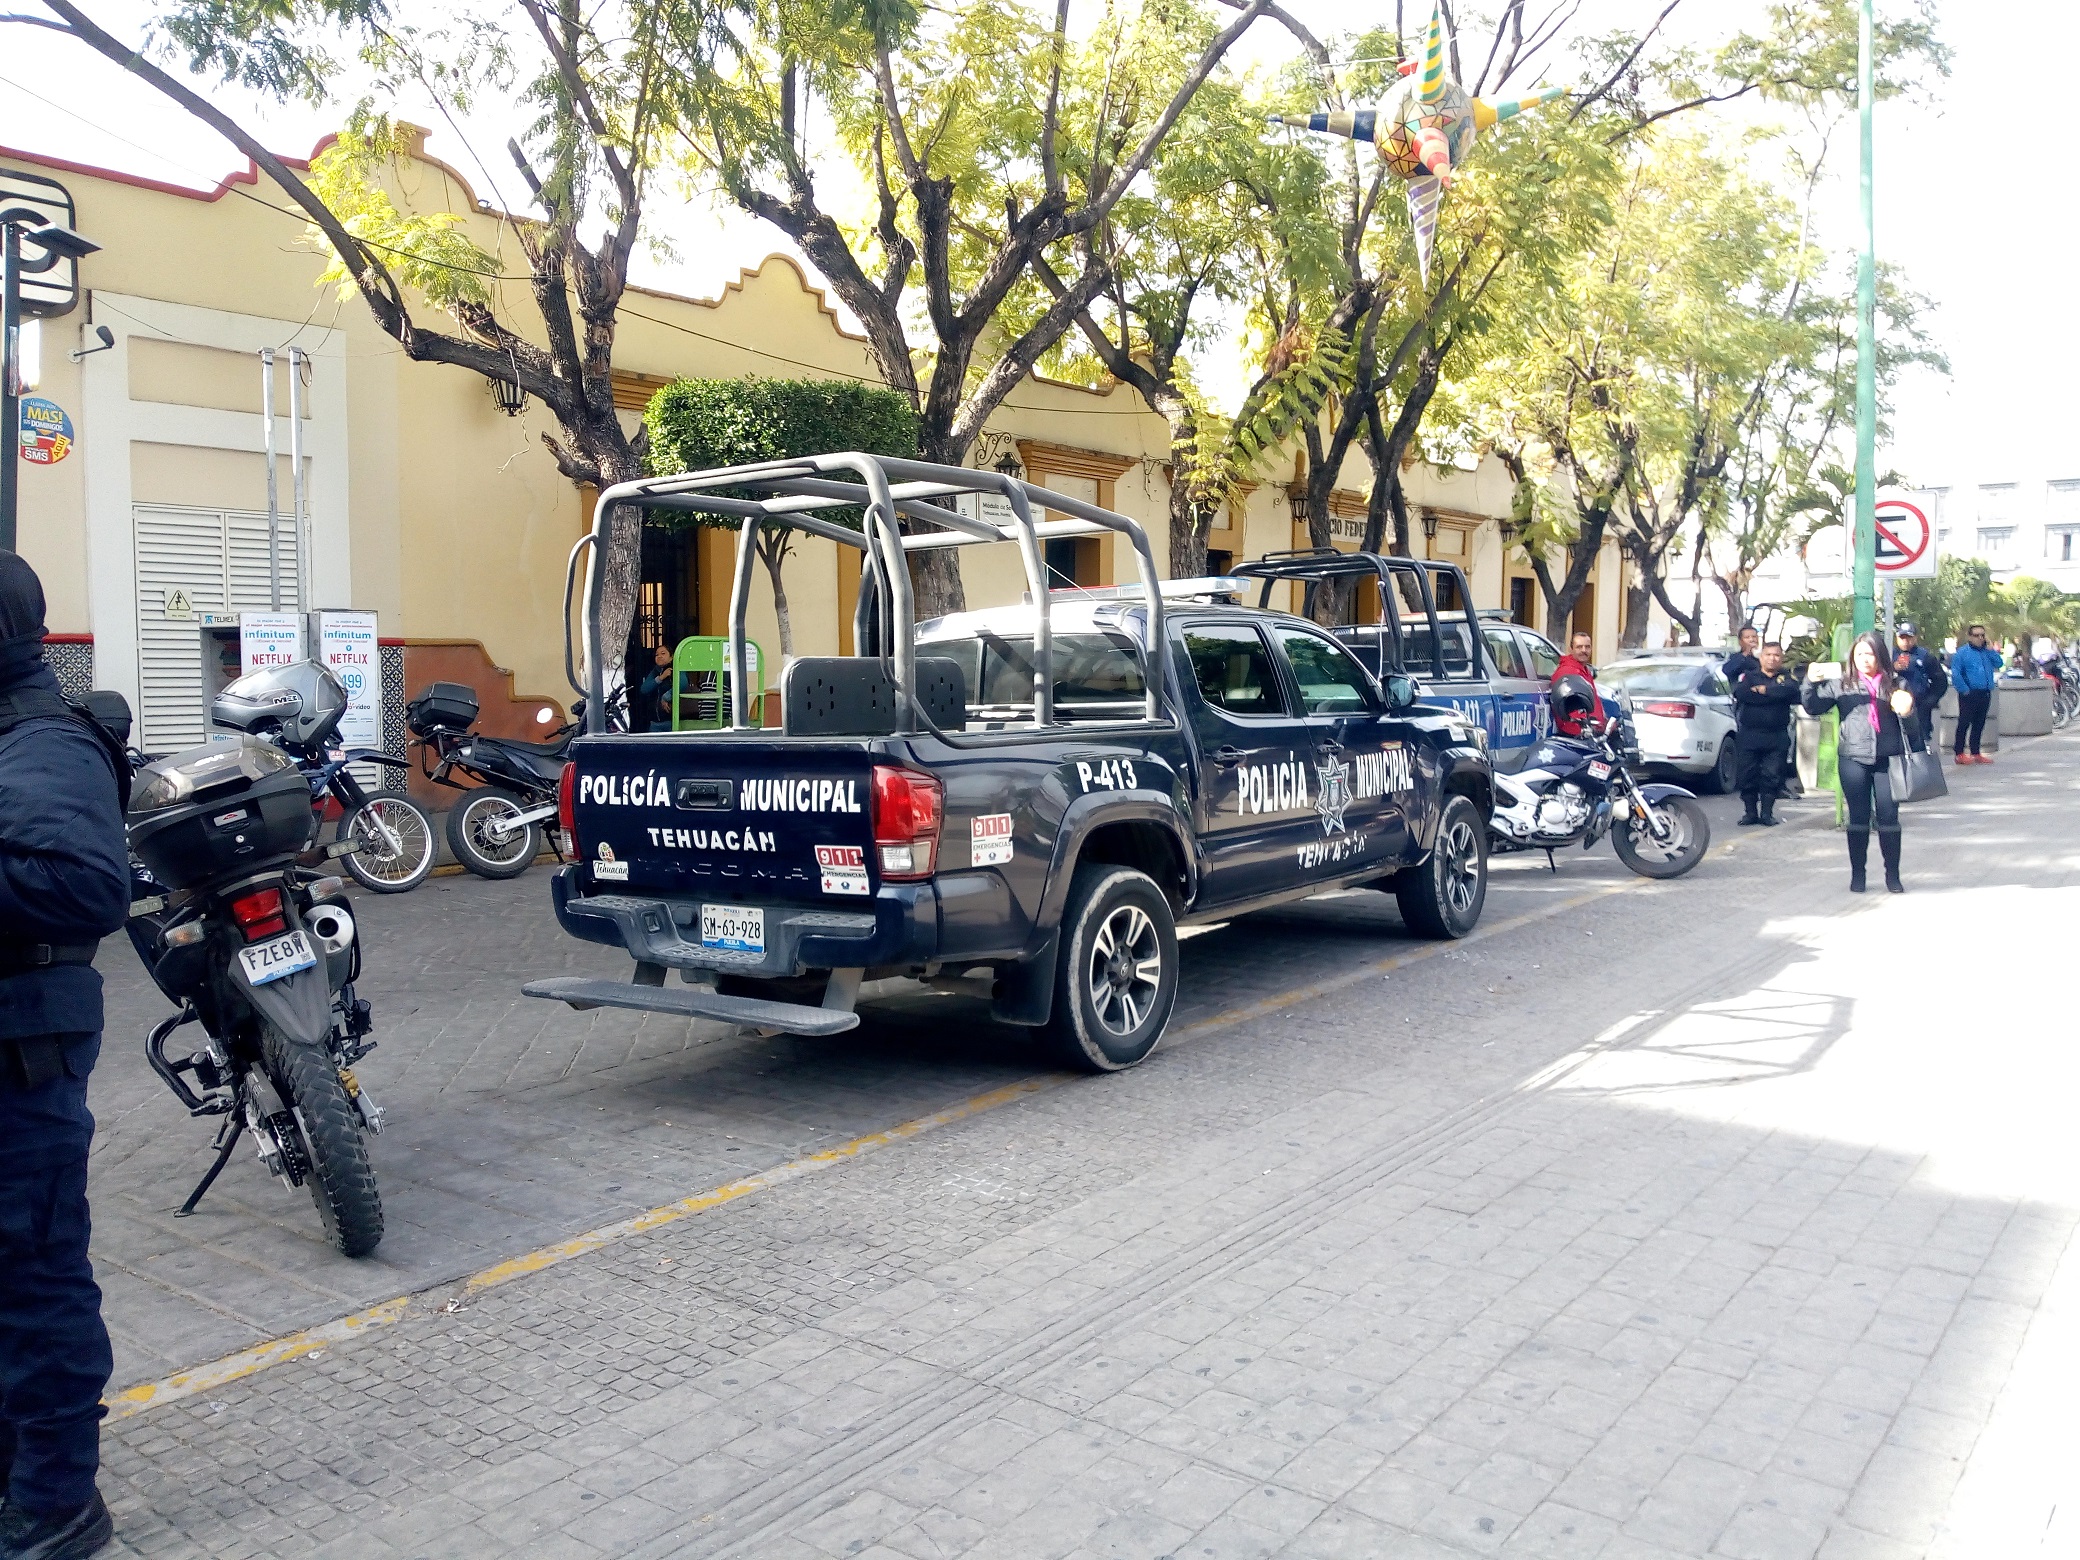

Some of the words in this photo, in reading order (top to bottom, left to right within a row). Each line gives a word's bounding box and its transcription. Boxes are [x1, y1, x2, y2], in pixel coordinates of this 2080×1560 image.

[27, 405, 63, 424] MÁS!
[31, 420, 63, 432] DOMINGOS
[25, 449, 48, 461] SMS
[245, 630, 295, 639] infinitum
[324, 630, 371, 639] infinitum
[252, 653, 292, 665] NETFLIX
[330, 653, 368, 664] NETFLIX
[1502, 705, 1531, 737] POLICÍA
[1076, 759, 1138, 793] P-413
[1237, 750, 1308, 817] POLICÍA
[1355, 748, 1414, 800] MUNICIPAL
[580, 768, 671, 807] POLICÍA
[740, 779, 861, 813] MUNICIPAL
[974, 818, 1008, 836] 911
[647, 826, 776, 852] TEHUACÁN
[973, 841, 1012, 851] EMERGENCIAS
[819, 849, 860, 865] 911
[823, 871, 867, 879] EMERGENCIAS
[703, 916, 761, 939] SM-63-928
